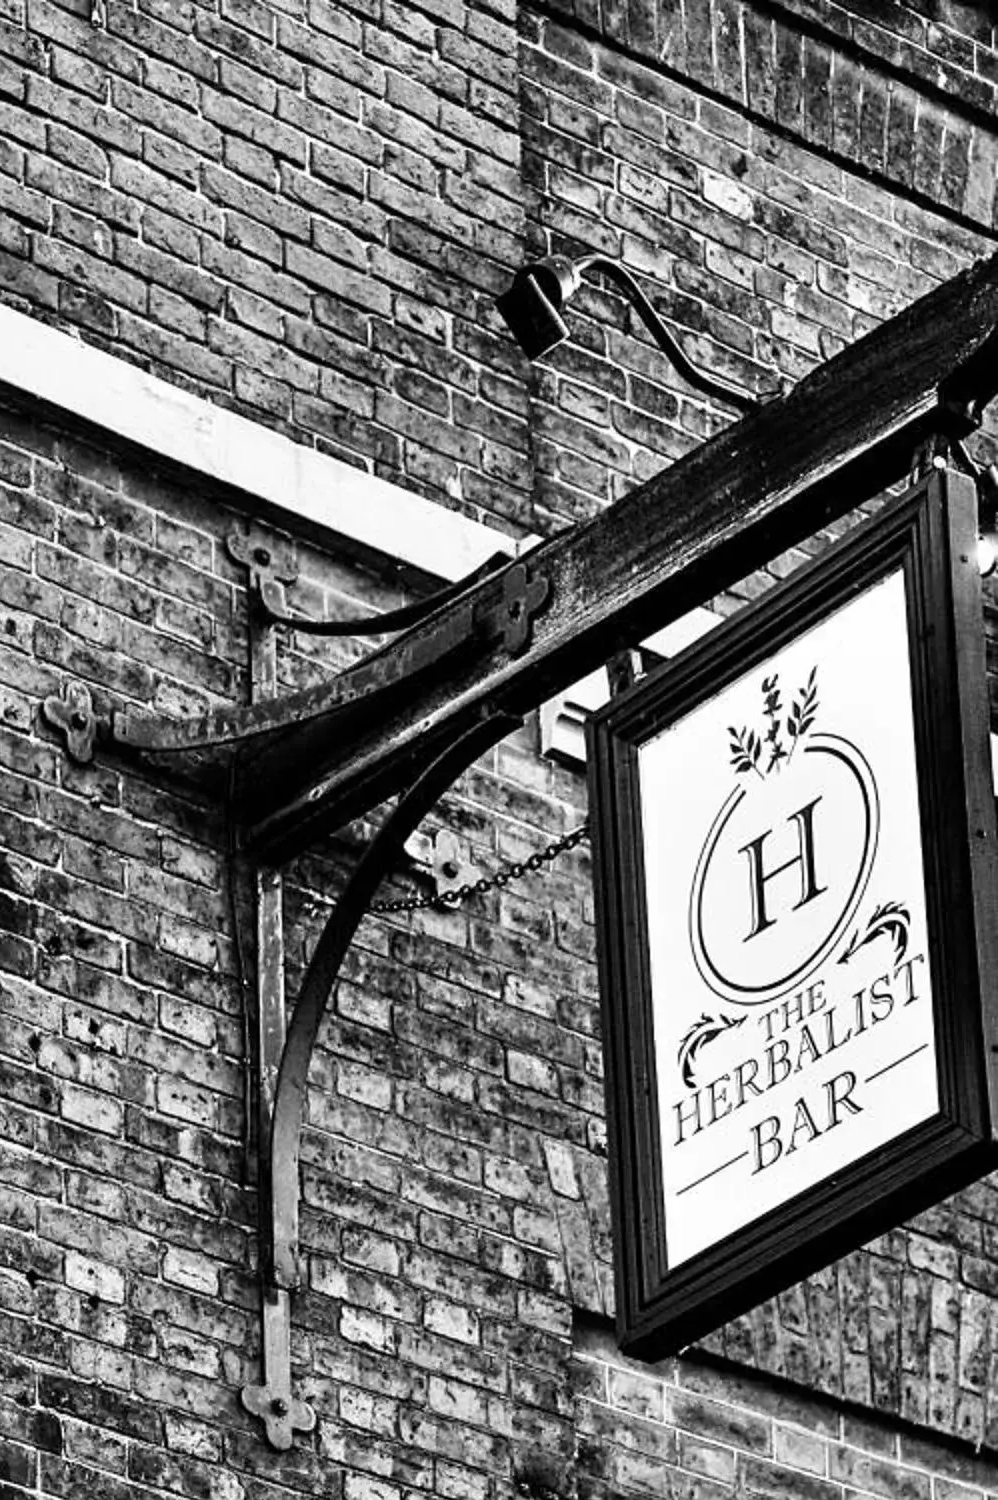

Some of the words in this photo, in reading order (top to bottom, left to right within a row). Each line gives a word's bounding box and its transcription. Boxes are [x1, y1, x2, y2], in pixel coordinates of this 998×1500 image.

[738, 796, 829, 943] H
[671, 953, 925, 1147] HERBALIST
[757, 979, 827, 1042] THE
[749, 1070, 865, 1176] BAR
